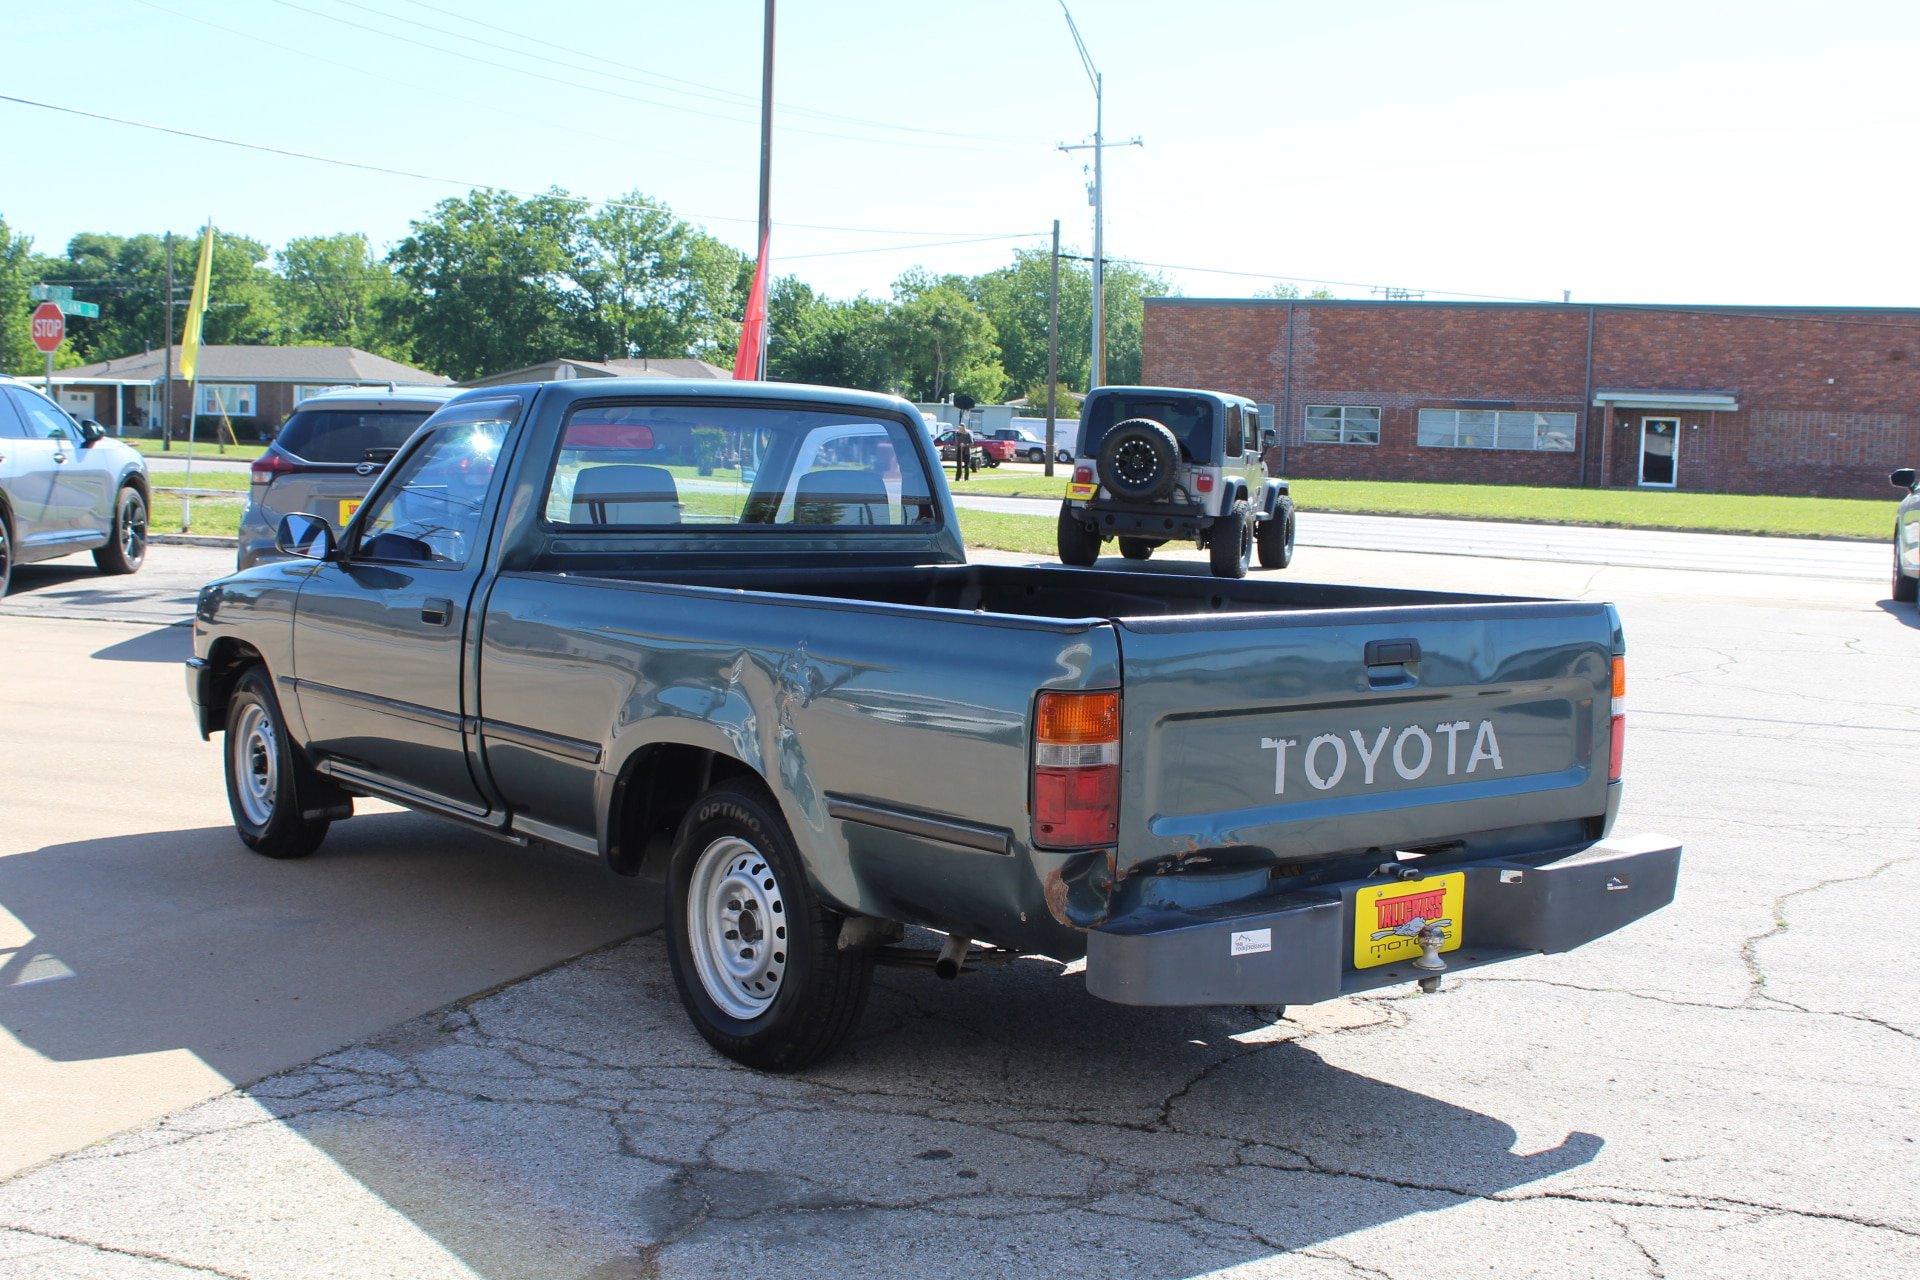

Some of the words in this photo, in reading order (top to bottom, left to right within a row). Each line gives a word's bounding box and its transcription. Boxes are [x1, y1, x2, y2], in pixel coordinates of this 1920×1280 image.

[34, 318, 62, 338] STOP
[1261, 719, 1504, 795] TOYOTA
[699, 802, 761, 833] OPTIMO
[1374, 887, 1447, 930] TALLGRASS
[1370, 930, 1453, 955] MOTS
